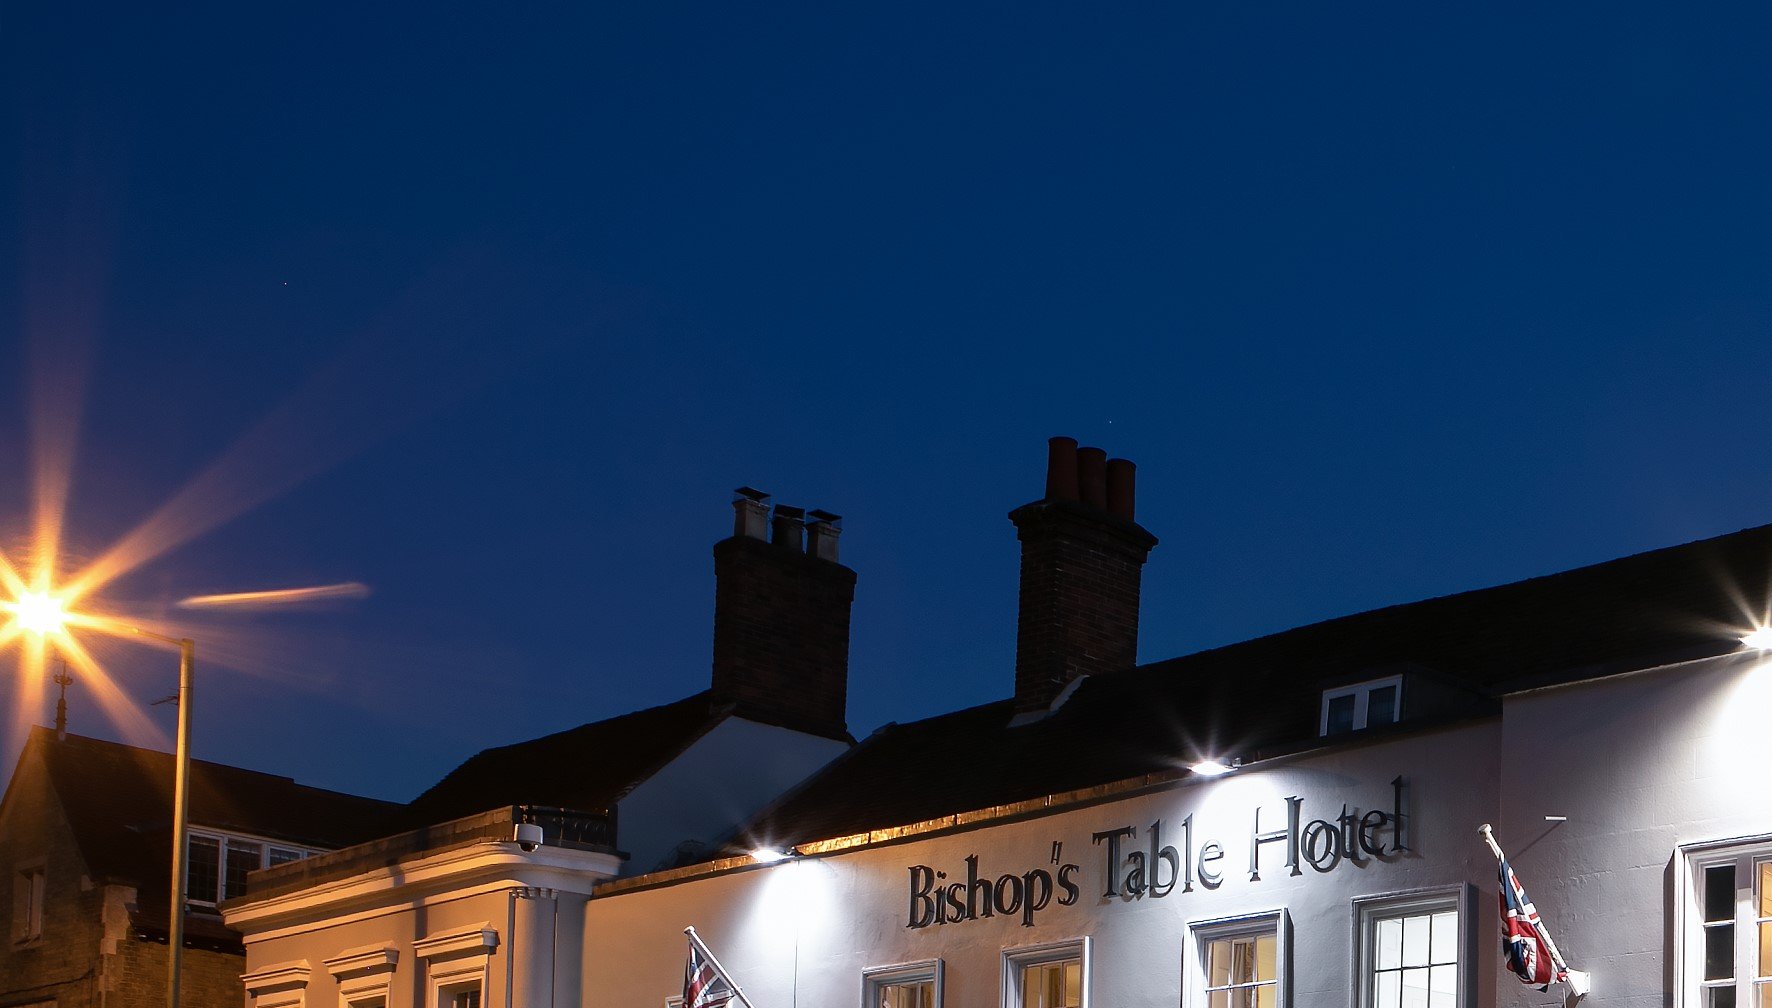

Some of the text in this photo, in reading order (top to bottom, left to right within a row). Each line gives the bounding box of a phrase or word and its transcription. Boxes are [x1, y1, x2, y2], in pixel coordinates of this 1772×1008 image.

[906, 775, 1410, 930] Bishop's Table Hotel
